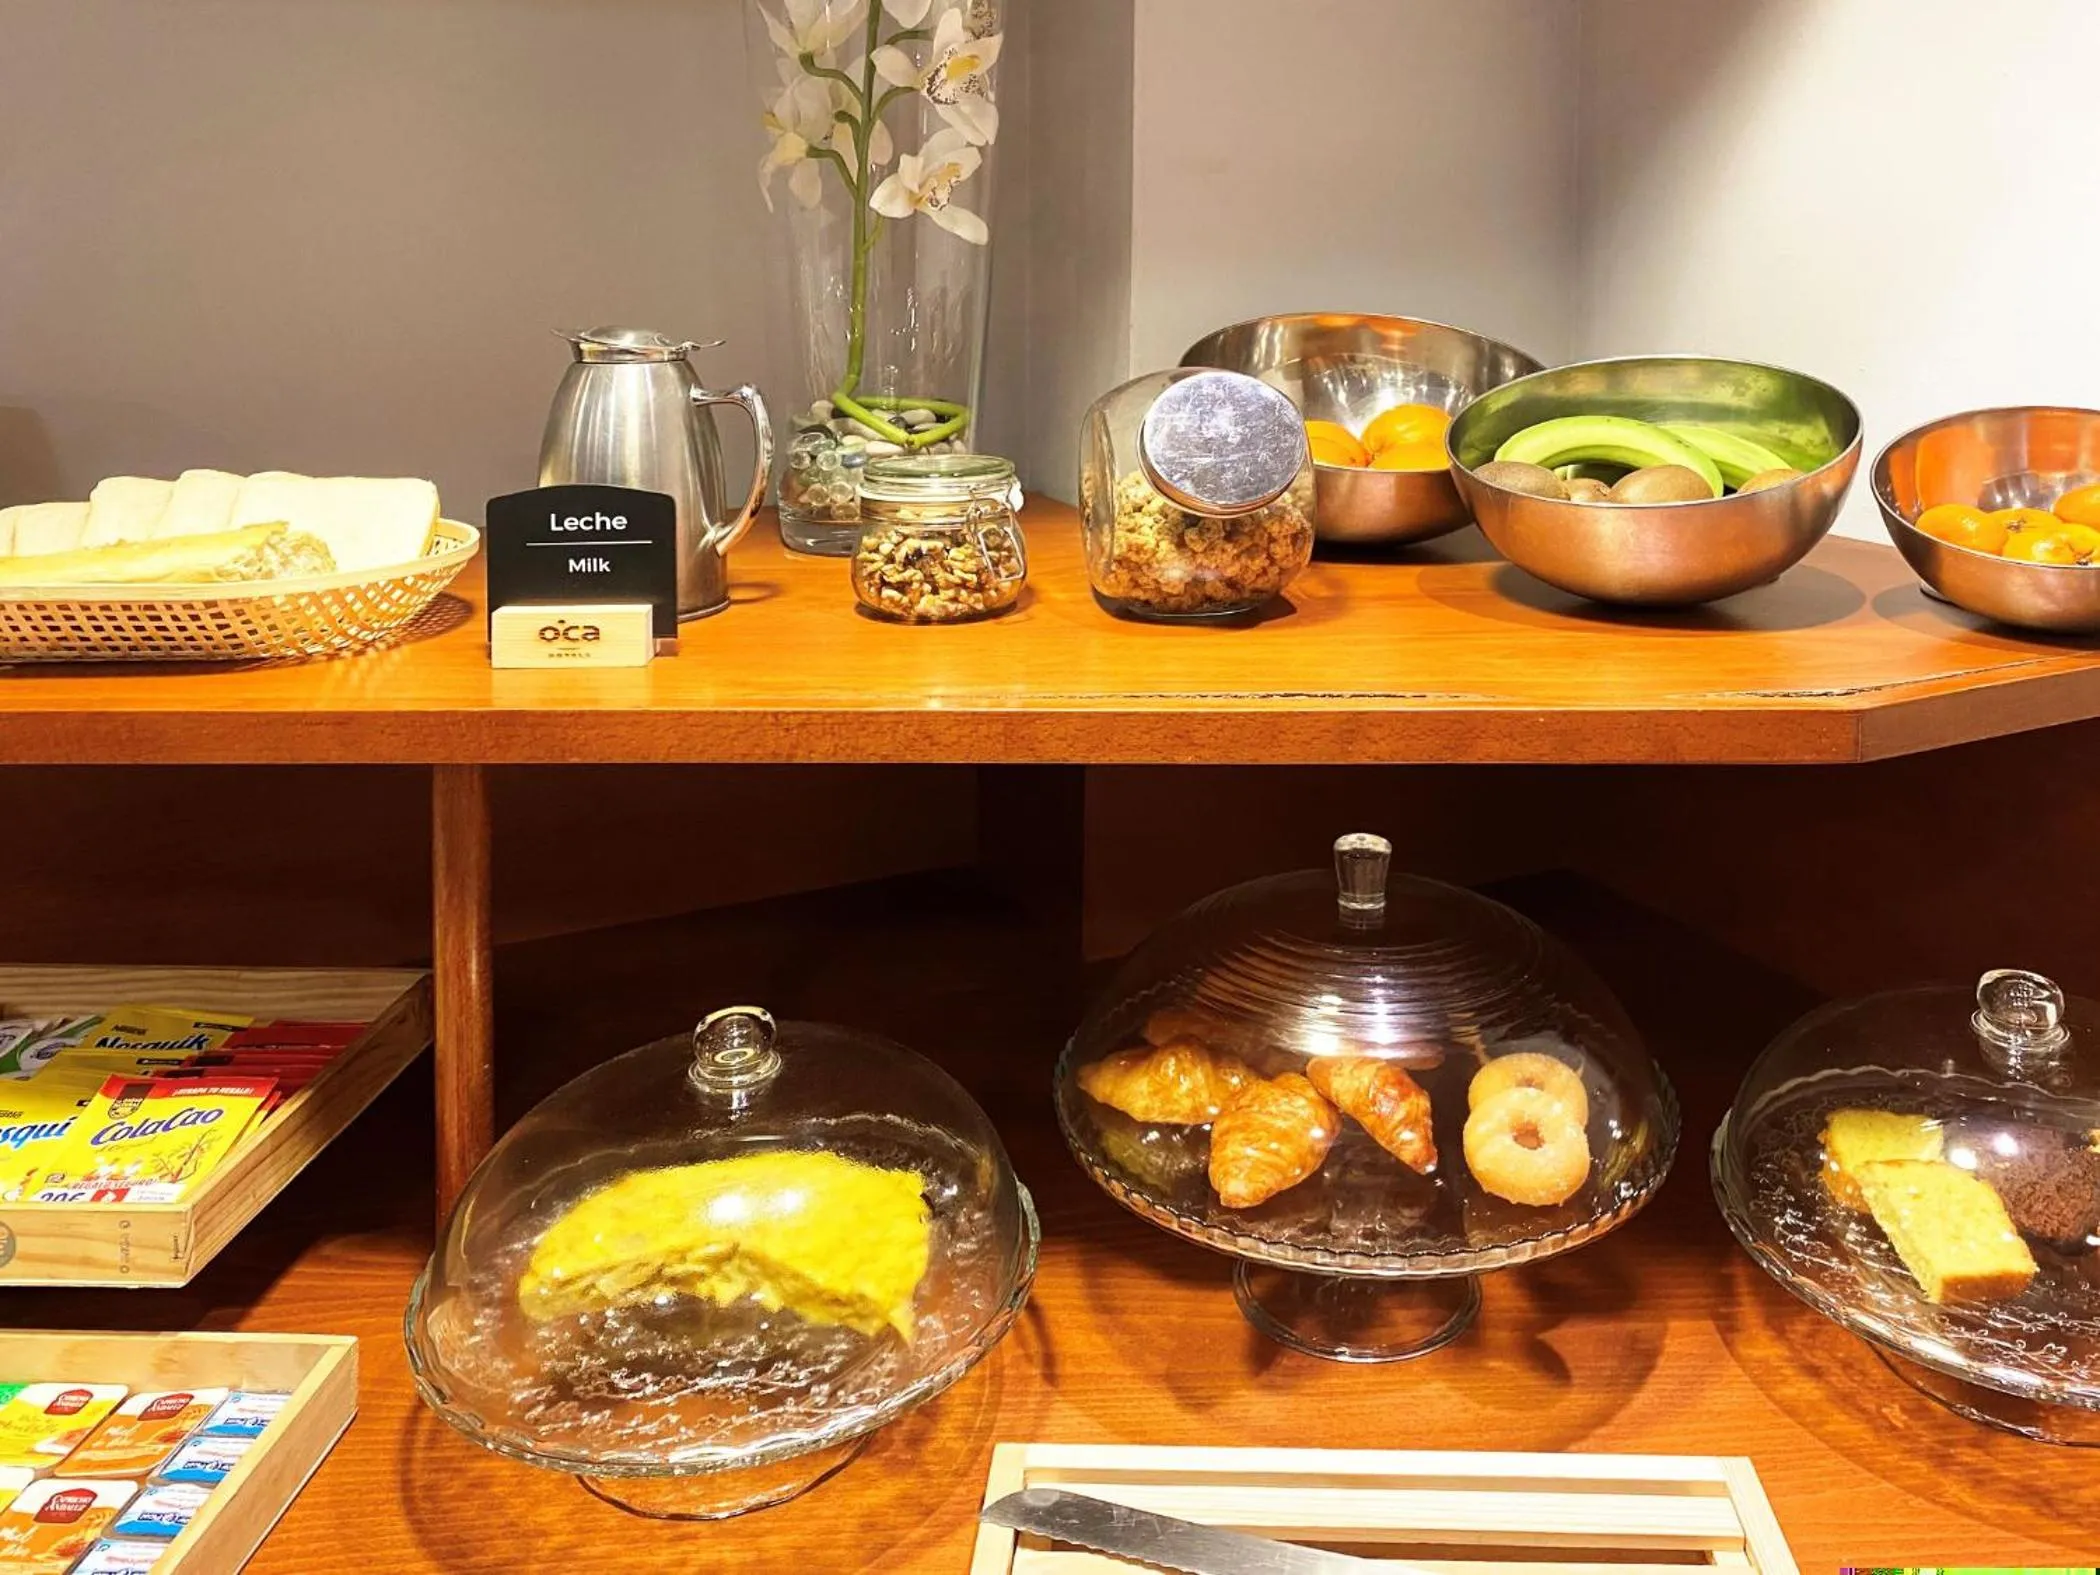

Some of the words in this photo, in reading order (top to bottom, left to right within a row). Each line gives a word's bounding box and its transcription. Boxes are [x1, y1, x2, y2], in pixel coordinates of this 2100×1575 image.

[550, 511, 628, 532] Leche
[568, 557, 611, 573] Milk
[90, 1107, 224, 1146] ColaCao
